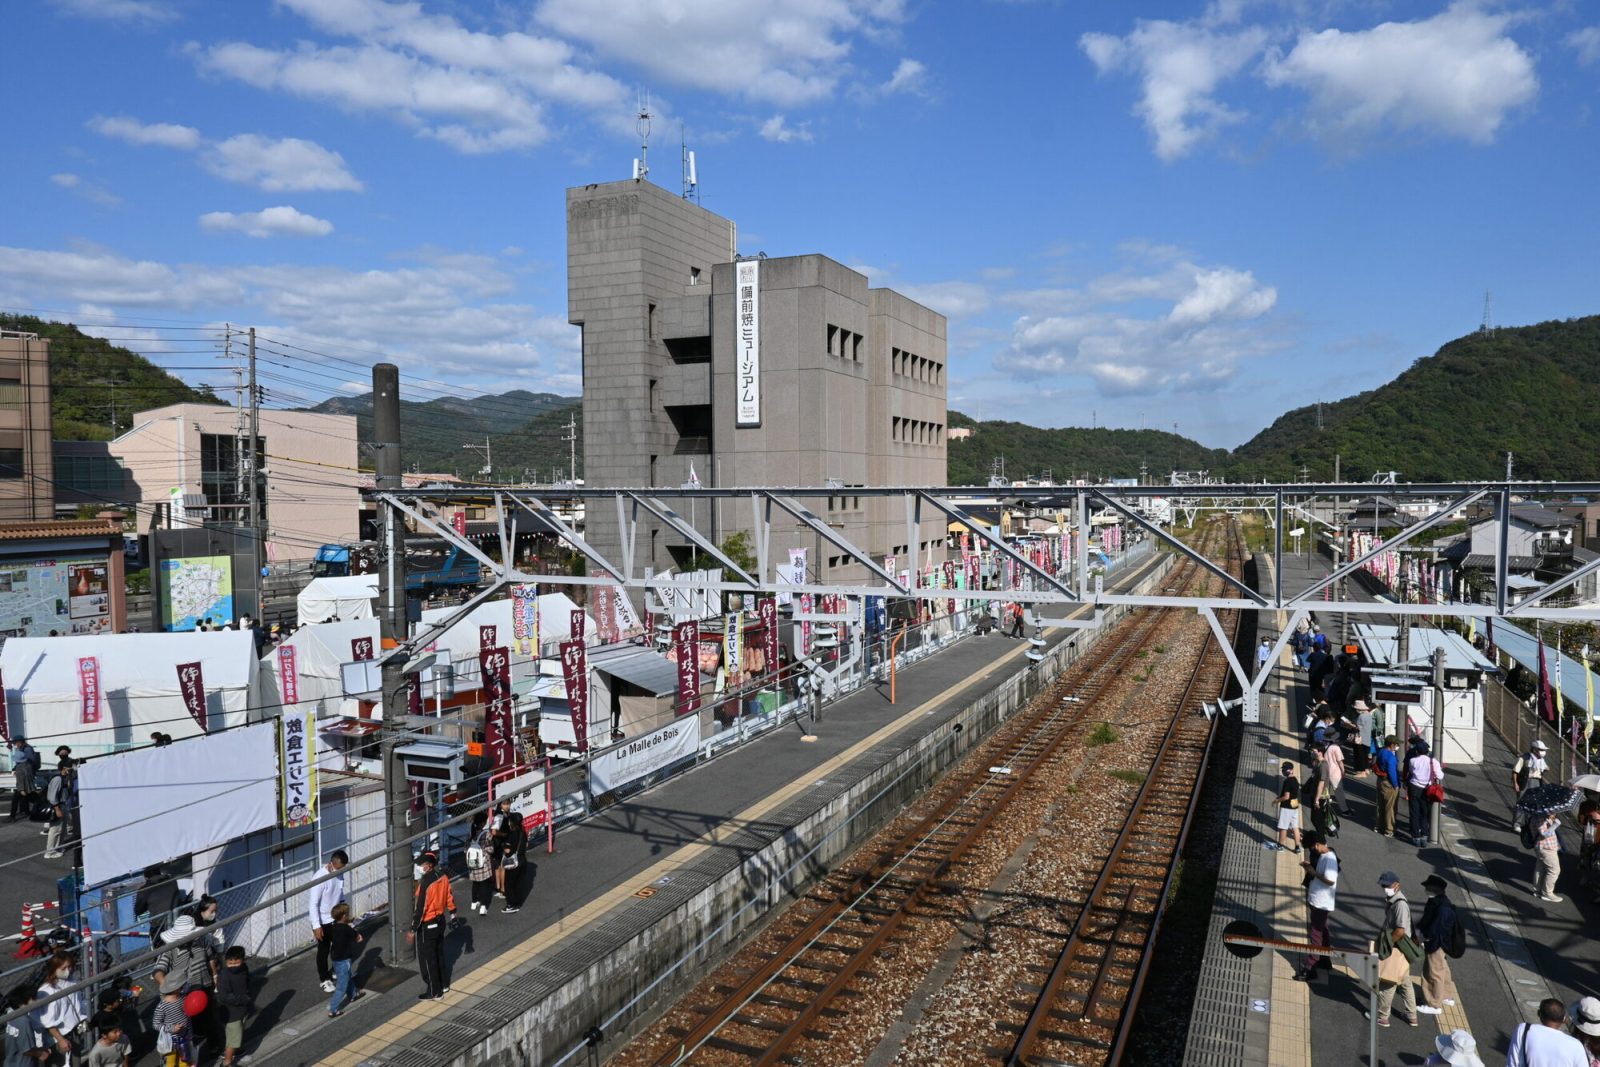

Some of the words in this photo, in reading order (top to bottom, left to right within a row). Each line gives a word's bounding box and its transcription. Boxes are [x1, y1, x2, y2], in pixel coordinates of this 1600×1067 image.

[741, 286, 754, 403] 備前焼ミュージアム
[1458, 705, 1463, 718] 1
[616, 749, 627, 760] La
[629, 740, 651, 755] Malle
[653, 734, 662, 745] de
[663, 728, 679, 741] Bois
